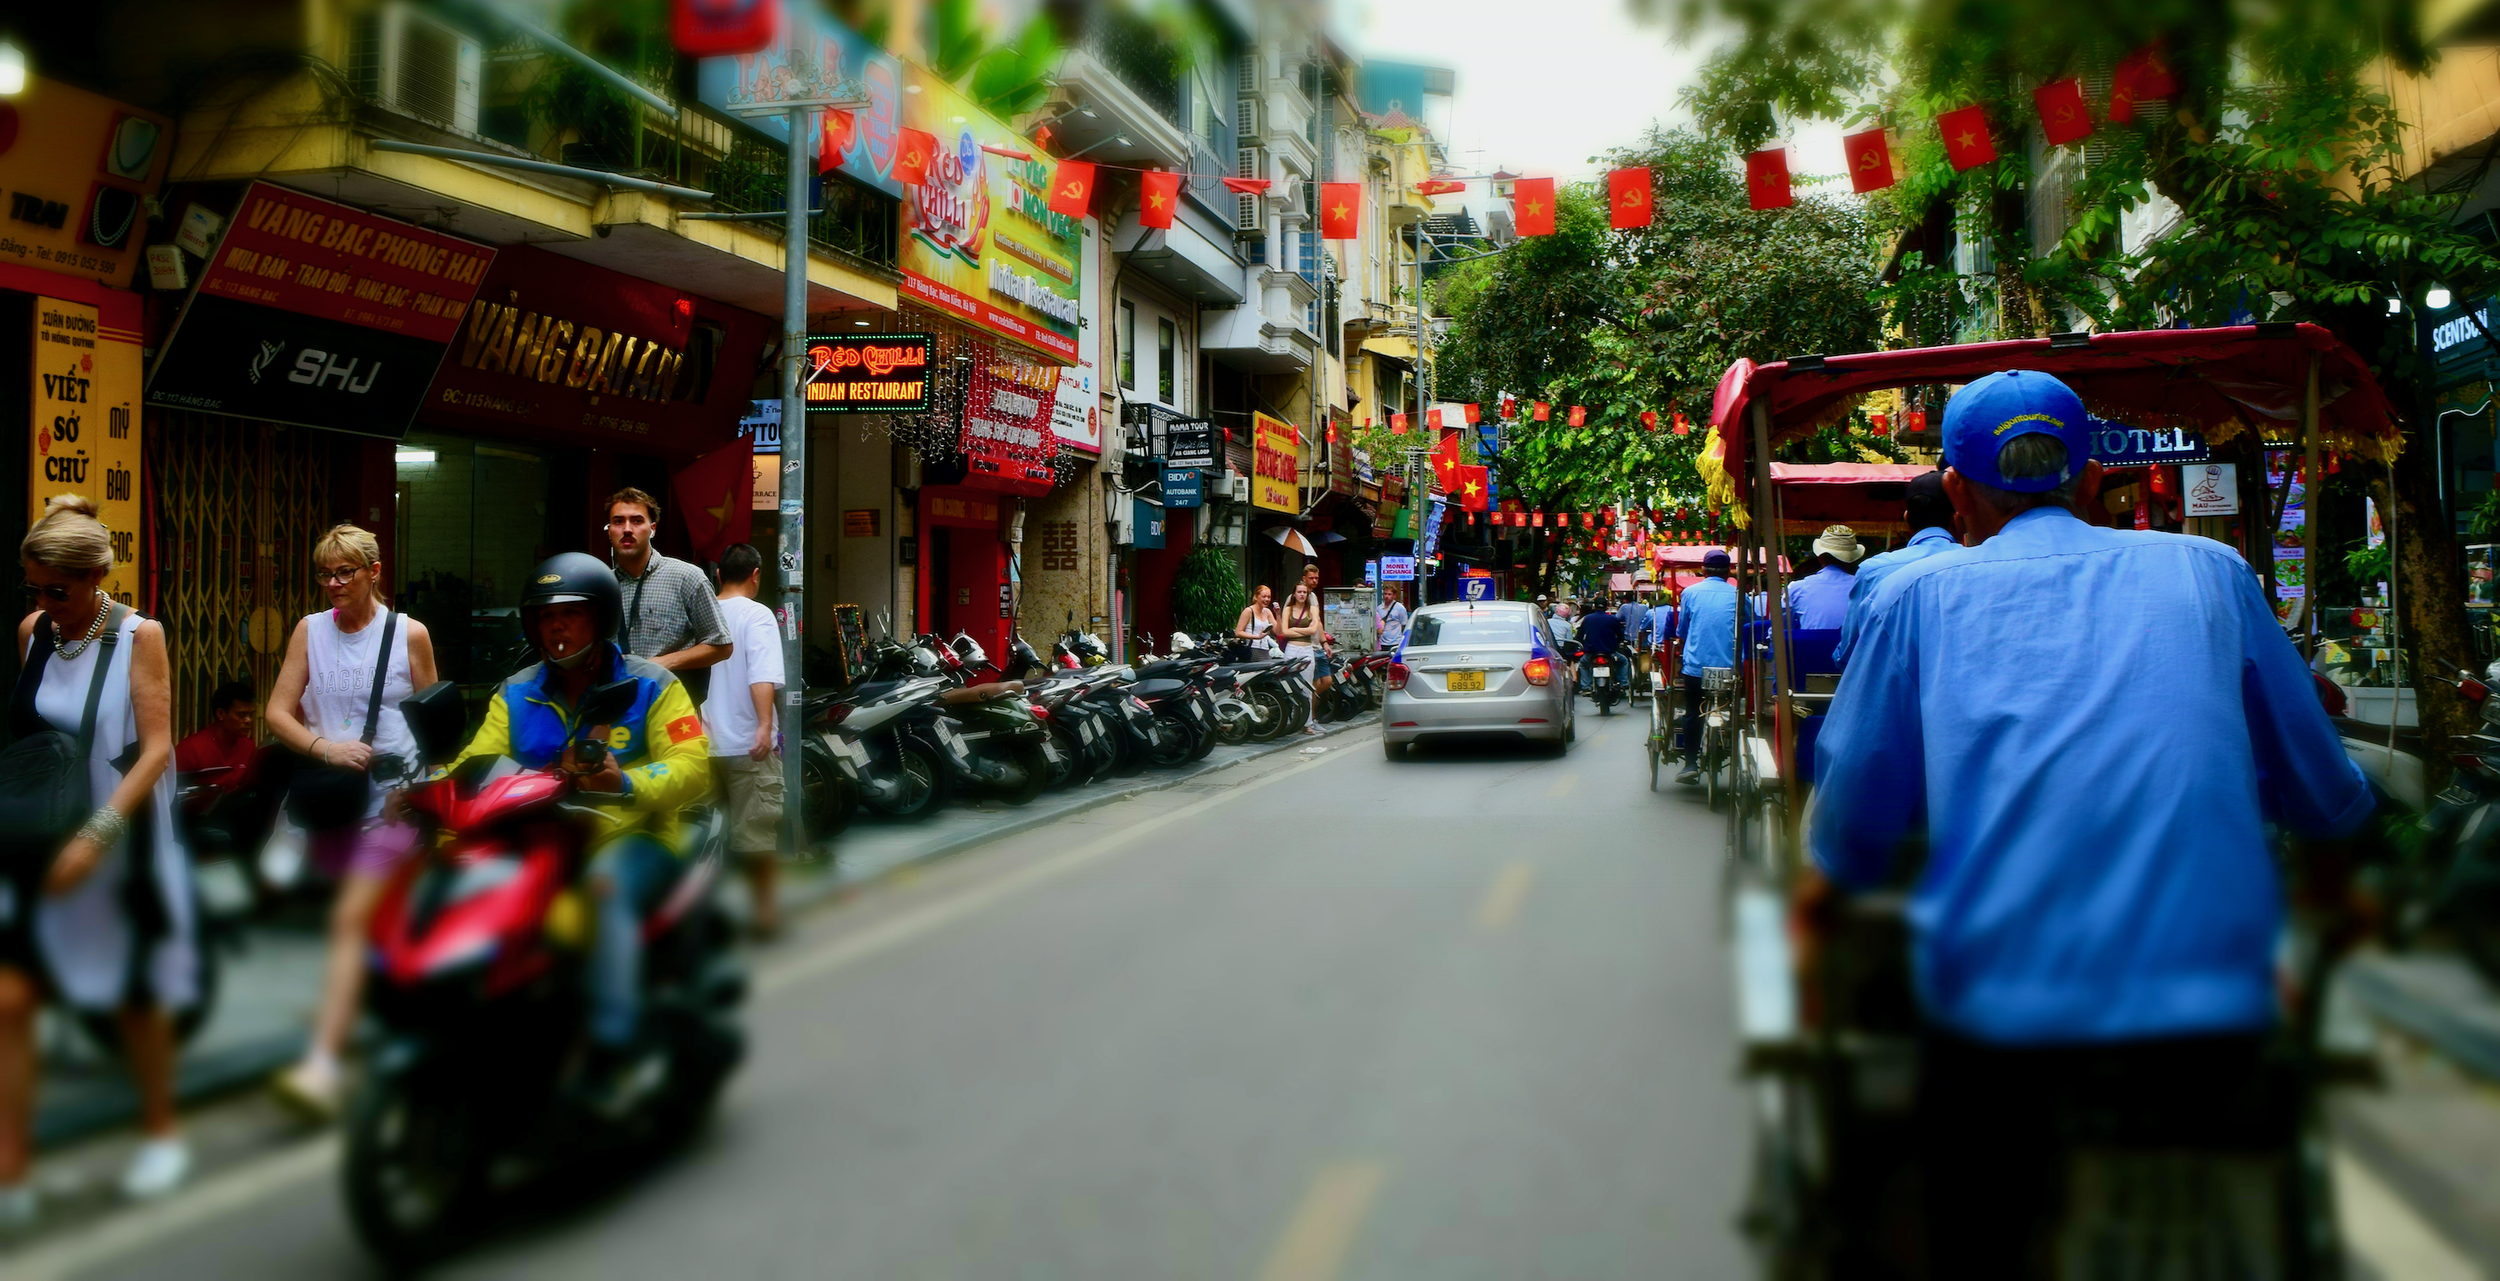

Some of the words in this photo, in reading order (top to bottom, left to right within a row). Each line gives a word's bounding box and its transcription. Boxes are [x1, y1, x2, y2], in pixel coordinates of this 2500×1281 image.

[1025, 161, 1047, 189] VEG
[1023, 189, 1048, 226] NON
[1049, 211, 1070, 238] VEG
[36, 246, 52, 261] Tel:
[55, 250, 78, 267] 0915
[81, 256, 96, 271] 052
[99, 260, 116, 274] 599
[319, 218, 375, 258] BẠC
[368, 231, 449, 276] PHONG
[443, 249, 487, 285] HẢI
[224, 246, 260, 274] MUA
[293, 263, 331, 289] TRAO
[442, 299, 467, 321] KIM
[990, 258, 1026, 302] Indian
[1025, 276, 1078, 326] Restaurant
[42, 309, 64, 330] XUÂN
[66, 312, 95, 334] ĐƯỜNG
[461, 289, 574, 384] VÀNG
[286, 347, 382, 395] SHJ
[808, 345, 861, 374] RED
[862, 345, 925, 376] CHILLI
[807, 382, 846, 401] INDIAN
[849, 381, 924, 400] RESTAURANT
[1169, 423, 1190, 431] MAMA
[1190, 422, 1209, 430] TOUR
[1993, 413, 2065, 436] saigontourist.net
[45, 450, 89, 483] CHỮ
[1168, 473, 1188, 482] BIDV
[107, 461, 130, 501] BẢO
[1150, 520, 1161, 536] BIDV
[1467, 580, 1486, 598] G7
[1452, 682, 1481, 690] 689.92
[1458, 673, 1474, 681] 30E
